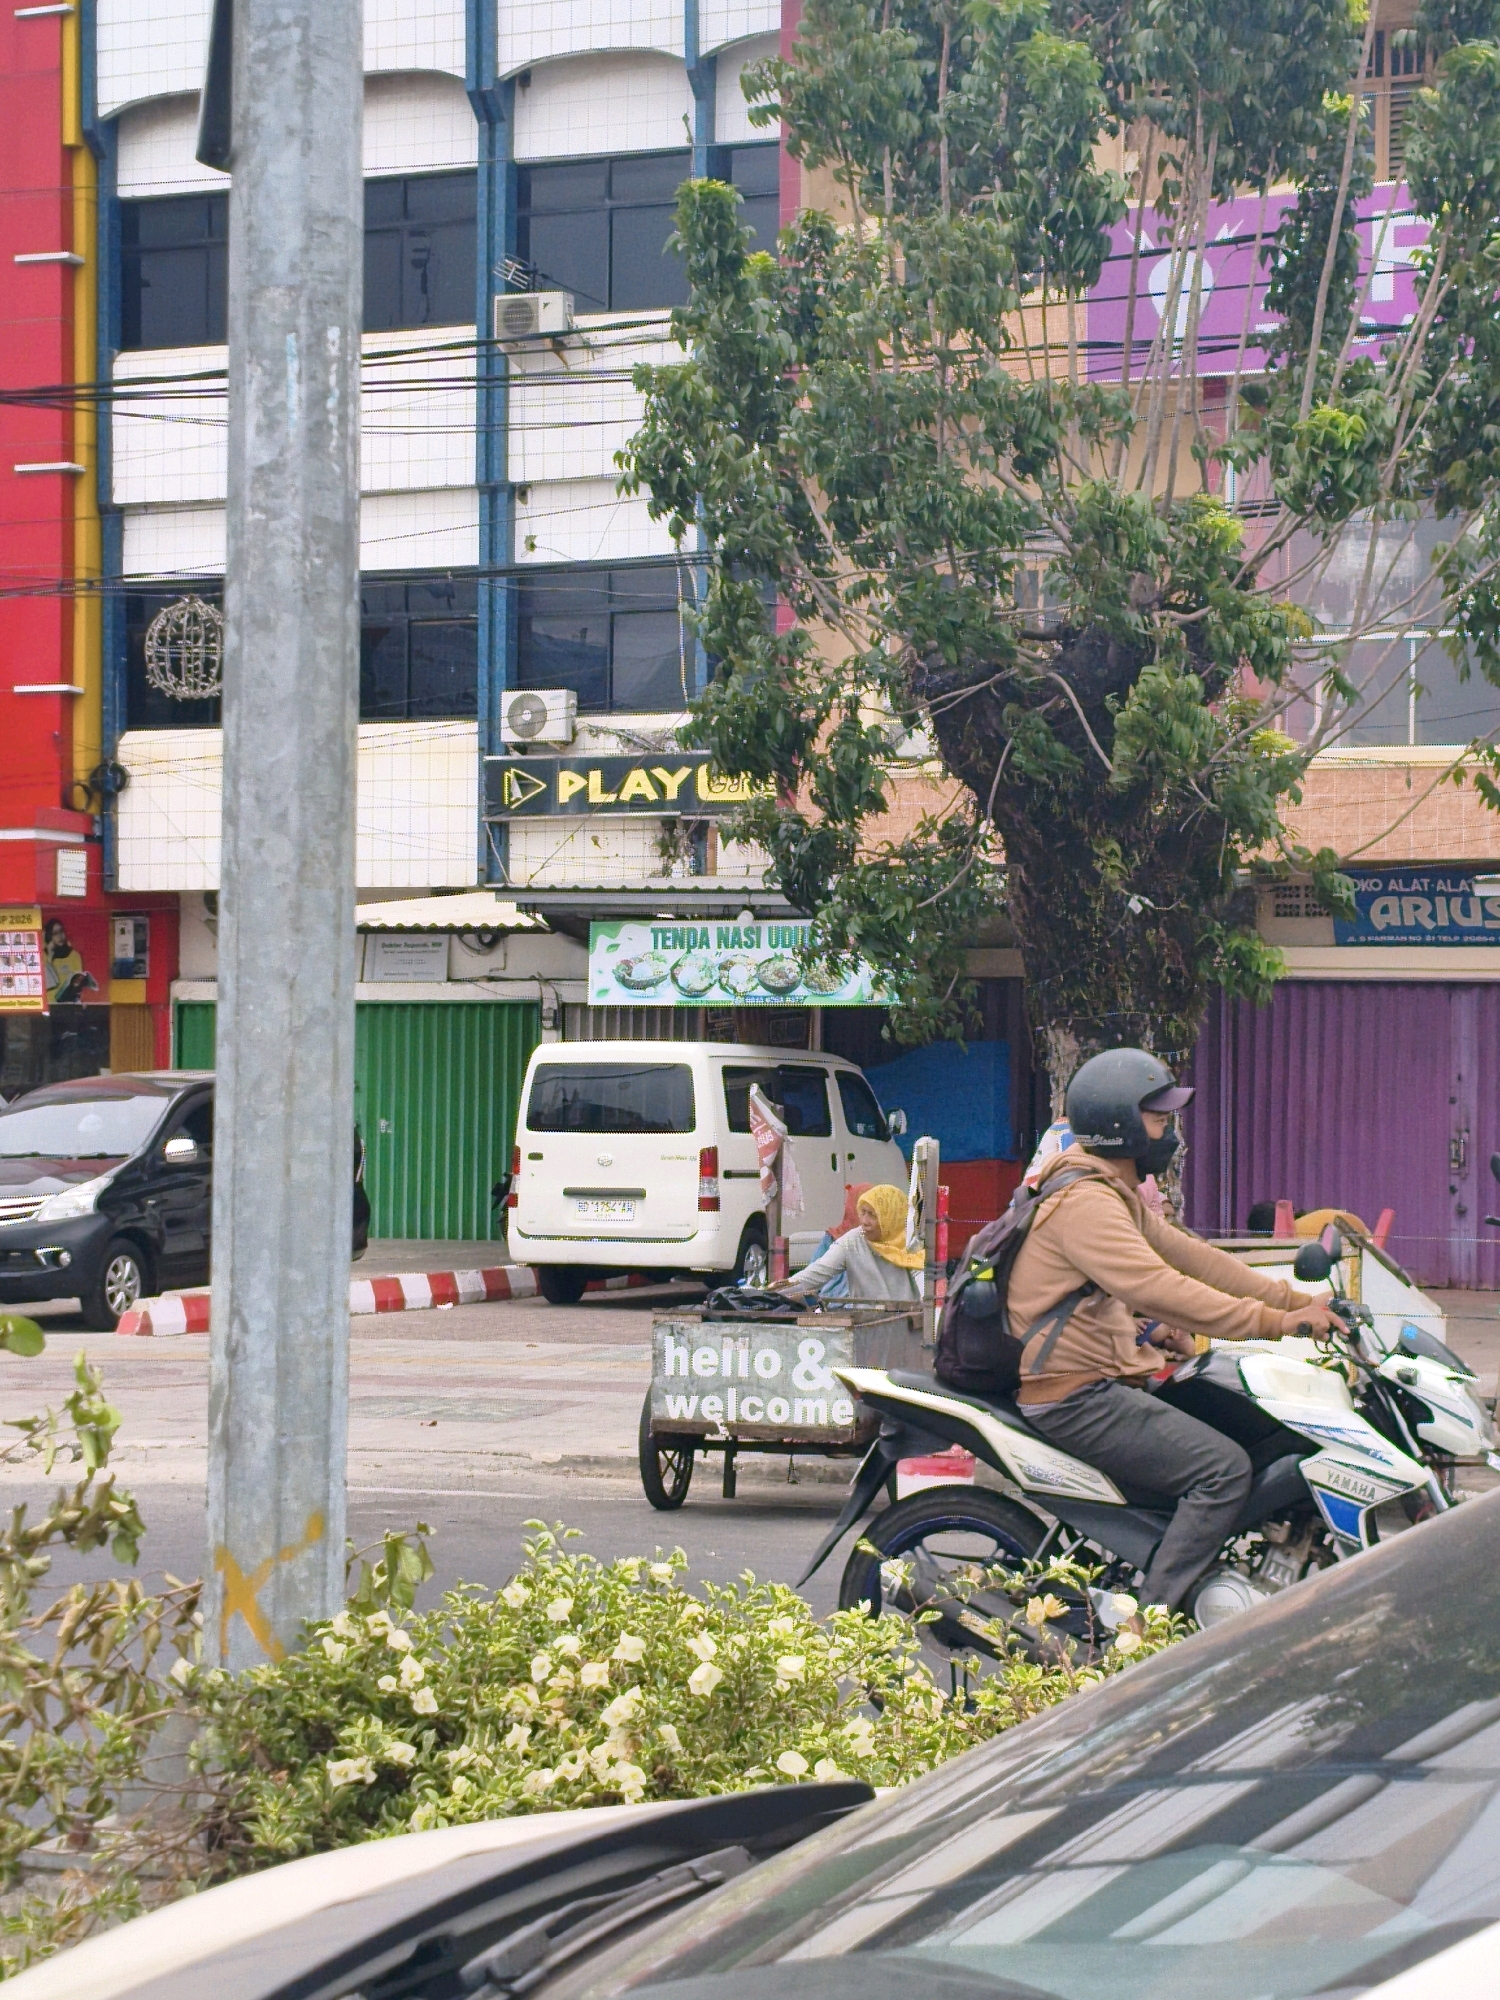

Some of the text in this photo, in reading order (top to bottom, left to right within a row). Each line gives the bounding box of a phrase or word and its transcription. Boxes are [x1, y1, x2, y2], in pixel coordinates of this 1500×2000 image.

[650, 926, 711, 950] TENDA
[716, 925, 762, 950] NASI
[664, 1335, 837, 1391] hello &
[665, 1387, 855, 1426] welcome
[1326, 1469, 1377, 1501] YAMAHA
